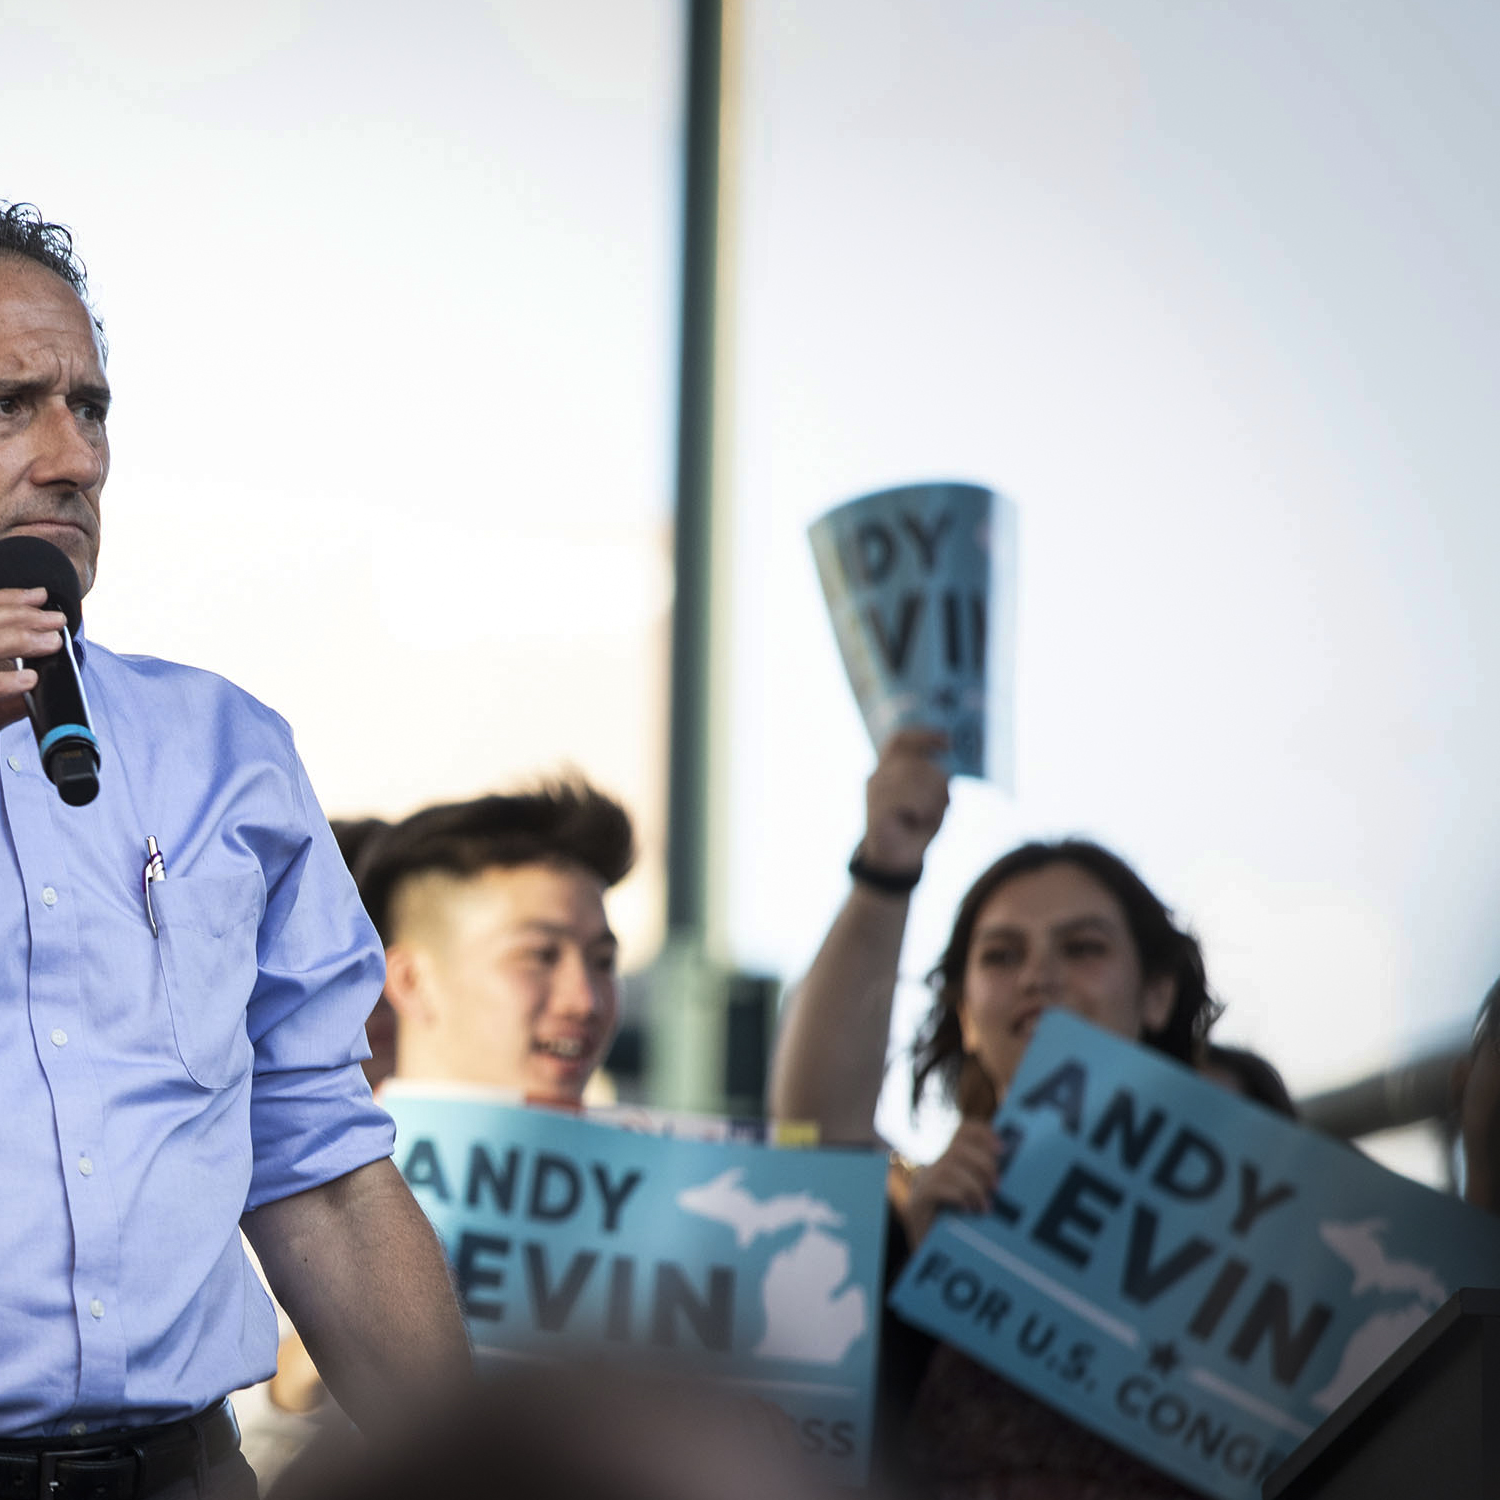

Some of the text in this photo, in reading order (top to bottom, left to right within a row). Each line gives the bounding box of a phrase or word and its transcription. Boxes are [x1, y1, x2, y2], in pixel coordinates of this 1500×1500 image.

[402, 1138, 642, 1234] ANDY
[1021, 1056, 1296, 1238] ANDY
[913, 1251, 1013, 1334] FOR
[1016, 1309, 1099, 1394] U.S.
[798, 1416, 857, 1458] SS
